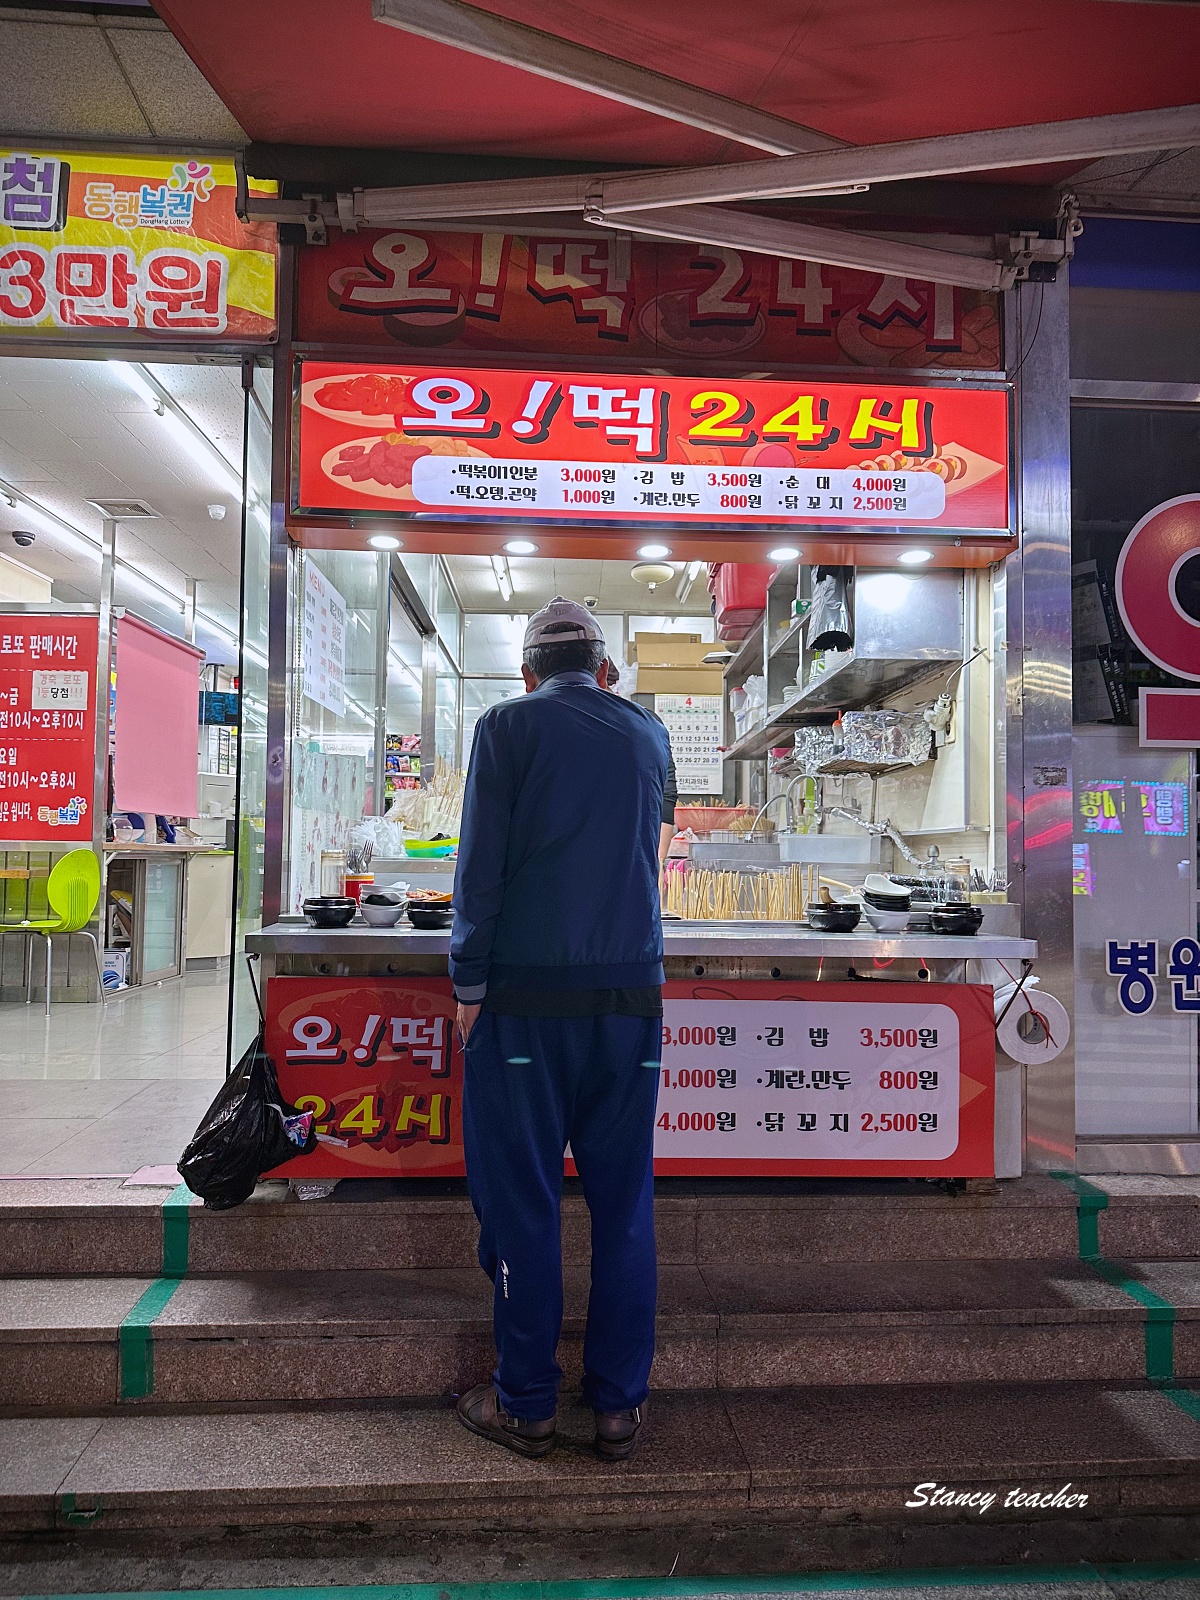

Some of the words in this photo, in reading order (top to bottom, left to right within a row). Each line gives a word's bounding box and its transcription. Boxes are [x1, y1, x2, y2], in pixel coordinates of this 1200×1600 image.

[86, 184, 193, 227] 동행복권
[169, 218, 190, 226] Lottery
[560, 467, 616, 484] 3,000원
[707, 472, 762, 489] 3,500원
[852, 477, 907, 493] 4,000원
[562, 489, 616, 505] 1,000원
[720, 494, 762, 509] 800원
[853, 497, 907, 511] 2,500원
[1, 635, 25, 654] 로또
[30, 635, 78, 660] 판매시간
[63, 674, 82, 685] 로또
[685, 697, 693, 706] 4
[38, 806, 79, 826] 동행복권
[661, 1026, 737, 1047] 3,000원
[859, 1028, 938, 1049] 3,500원
[662, 1068, 737, 1089] 1,000원
[878, 1070, 938, 1091] 800원
[656, 1112, 737, 1133] 4,000원
[860, 1113, 938, 1133] 2,500원
